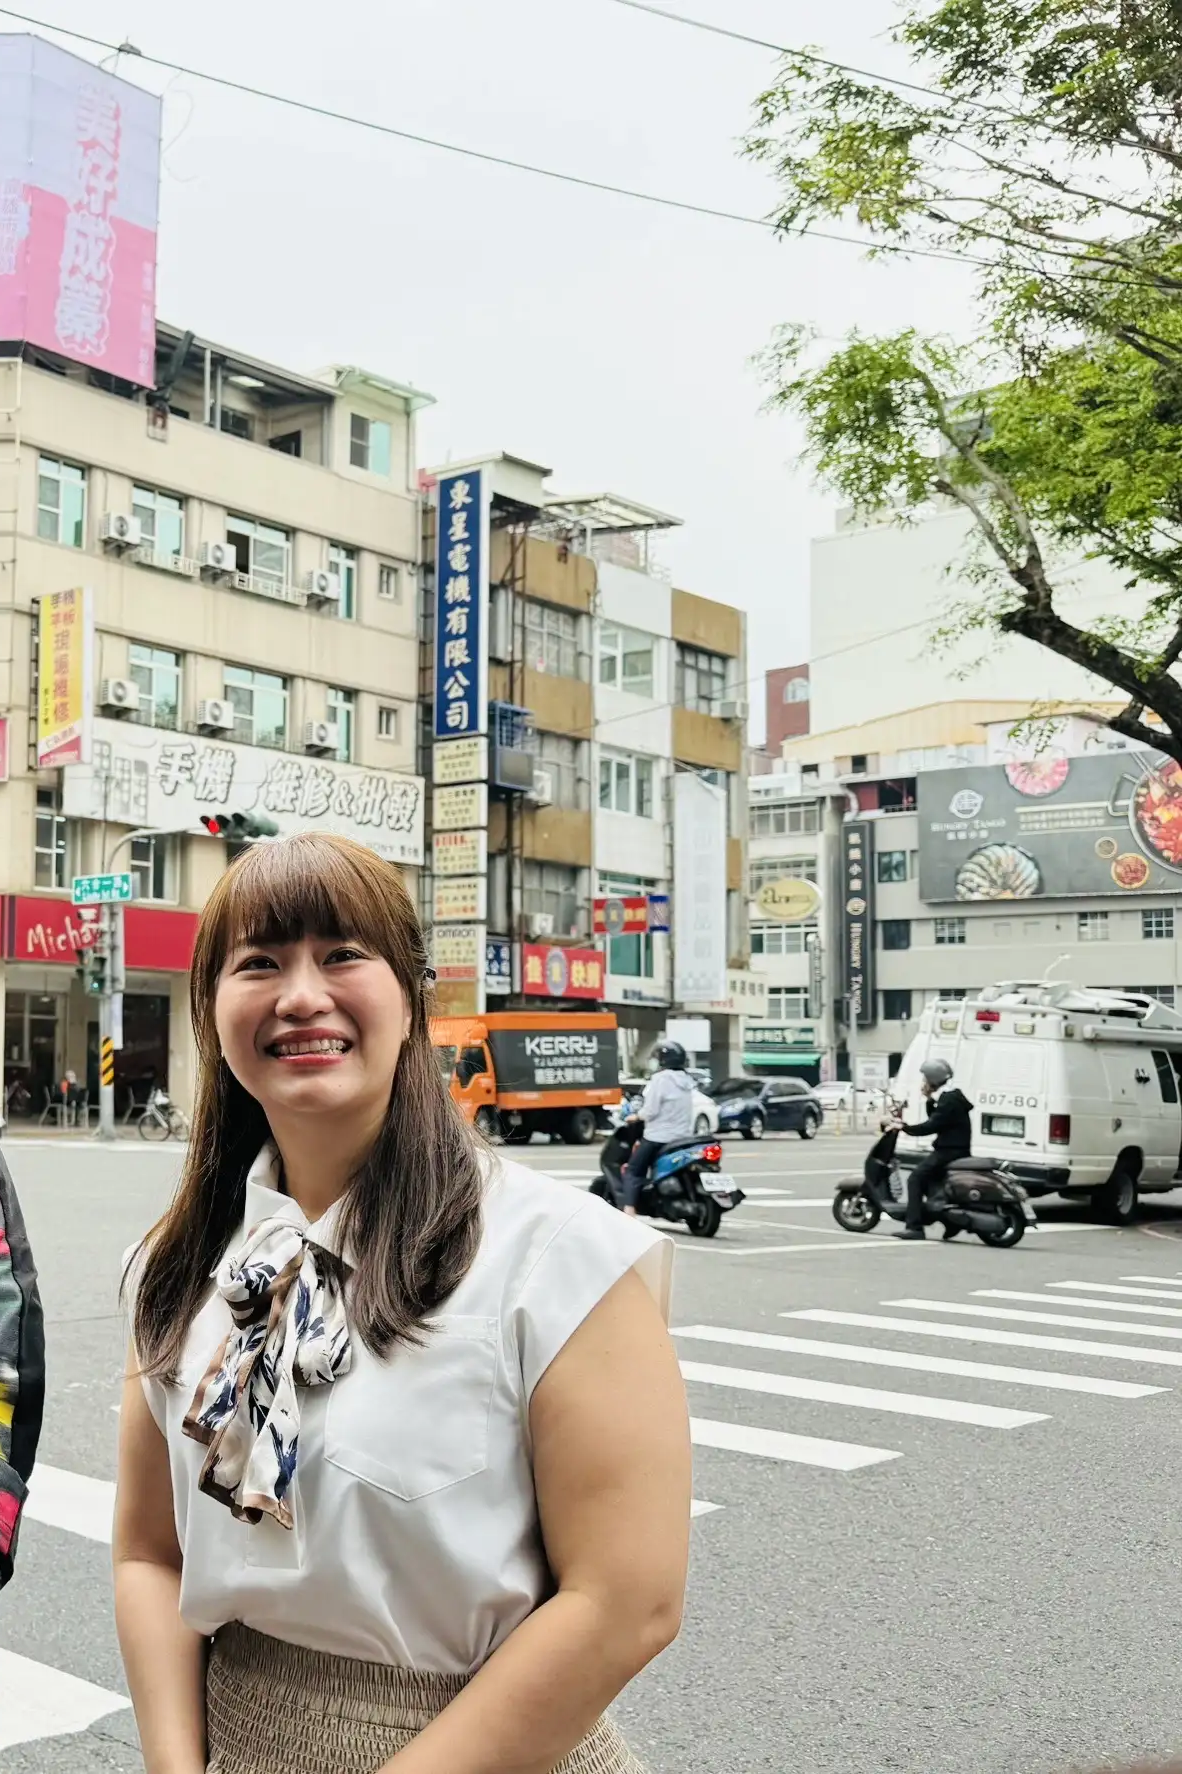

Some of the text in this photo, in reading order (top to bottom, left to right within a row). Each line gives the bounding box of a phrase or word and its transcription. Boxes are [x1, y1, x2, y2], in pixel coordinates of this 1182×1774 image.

[443, 479, 474, 732] 東星電機有限公司
[156, 742, 236, 804] 手機
[27, 916, 96, 958] Micha
[524, 1035, 598, 1055] KERRY
